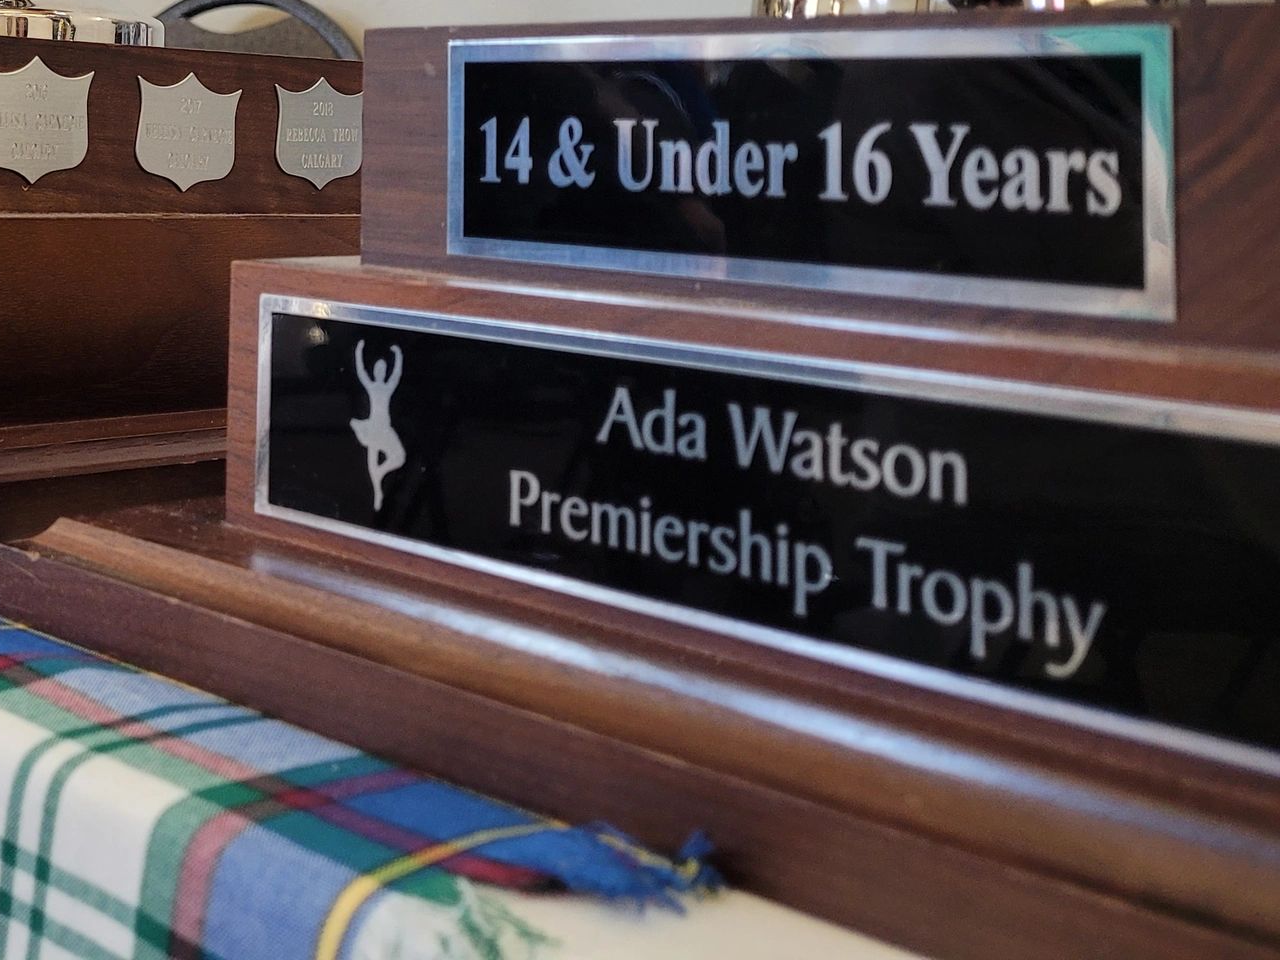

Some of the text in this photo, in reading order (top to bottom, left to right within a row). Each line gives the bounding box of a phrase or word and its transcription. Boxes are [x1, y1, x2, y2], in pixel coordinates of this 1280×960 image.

[301, 153, 344, 169] CALGARY
[478, 115, 1123, 218] 14 & Under 16 Years
[595, 384, 970, 507] Ada Watson
[507, 468, 1108, 680] Premiership Trophy
